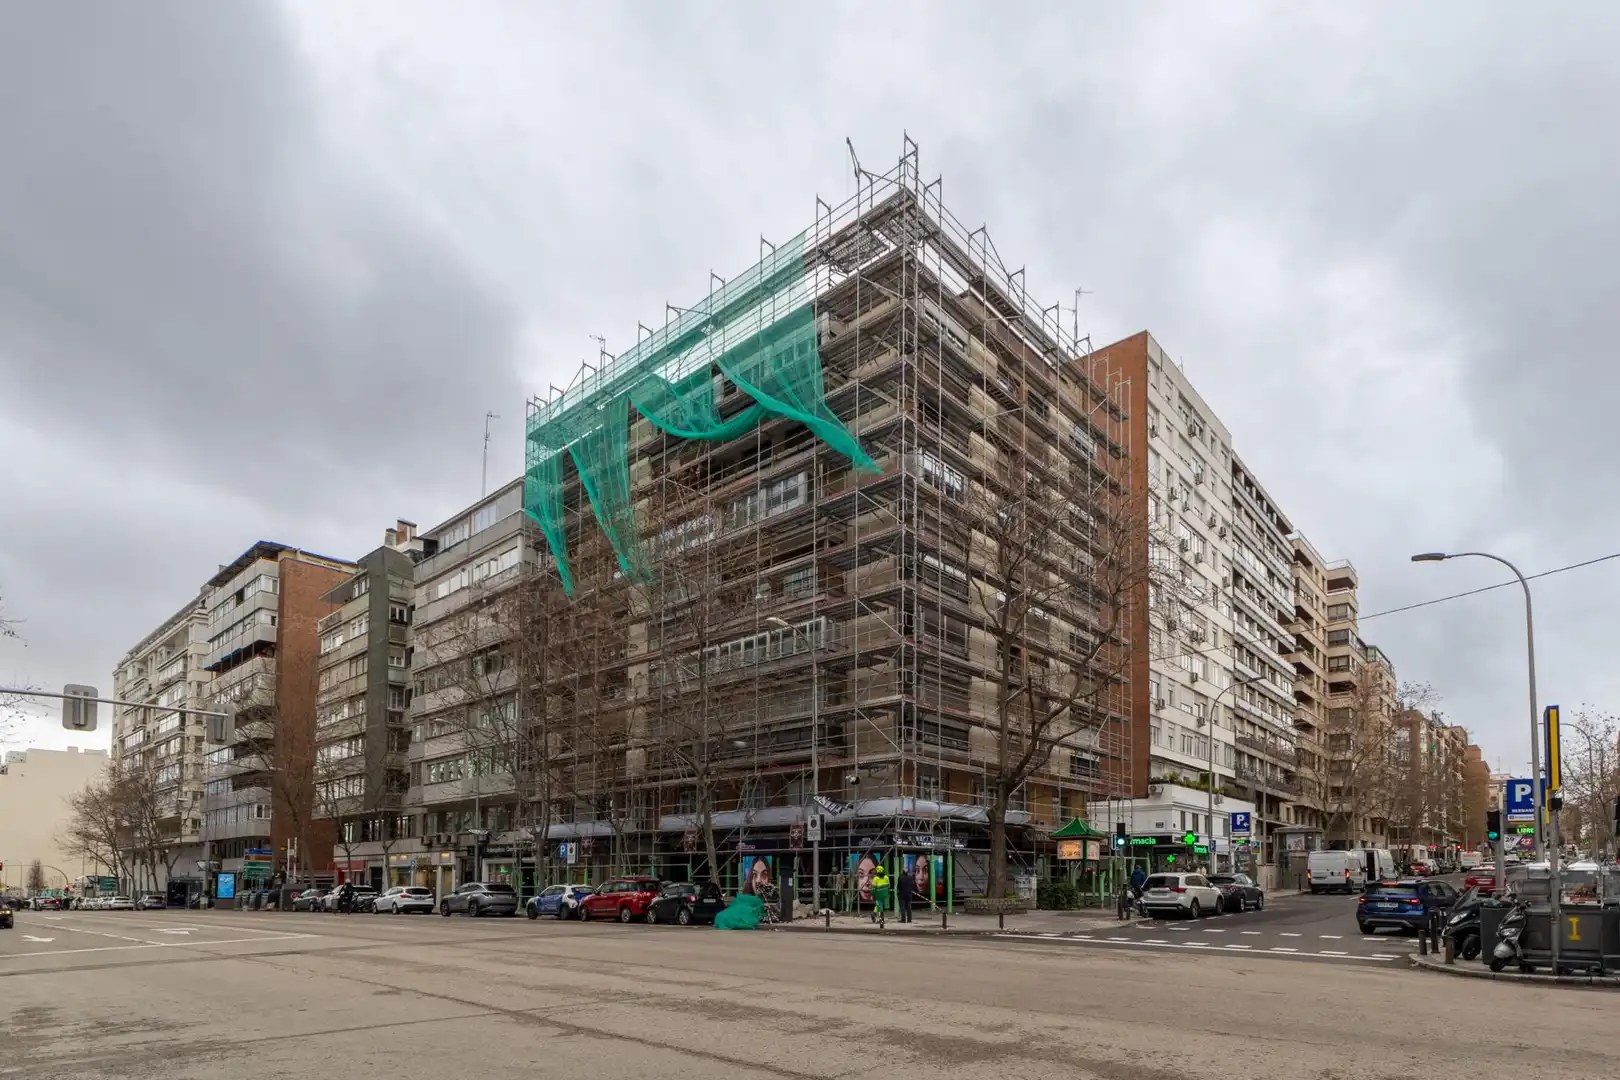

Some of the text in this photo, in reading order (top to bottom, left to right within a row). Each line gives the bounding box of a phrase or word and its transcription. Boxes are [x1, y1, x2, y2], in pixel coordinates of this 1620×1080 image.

[1515, 784, 1532, 803] P
[1236, 814, 1245, 826] P
[560, 845, 567, 856] P
